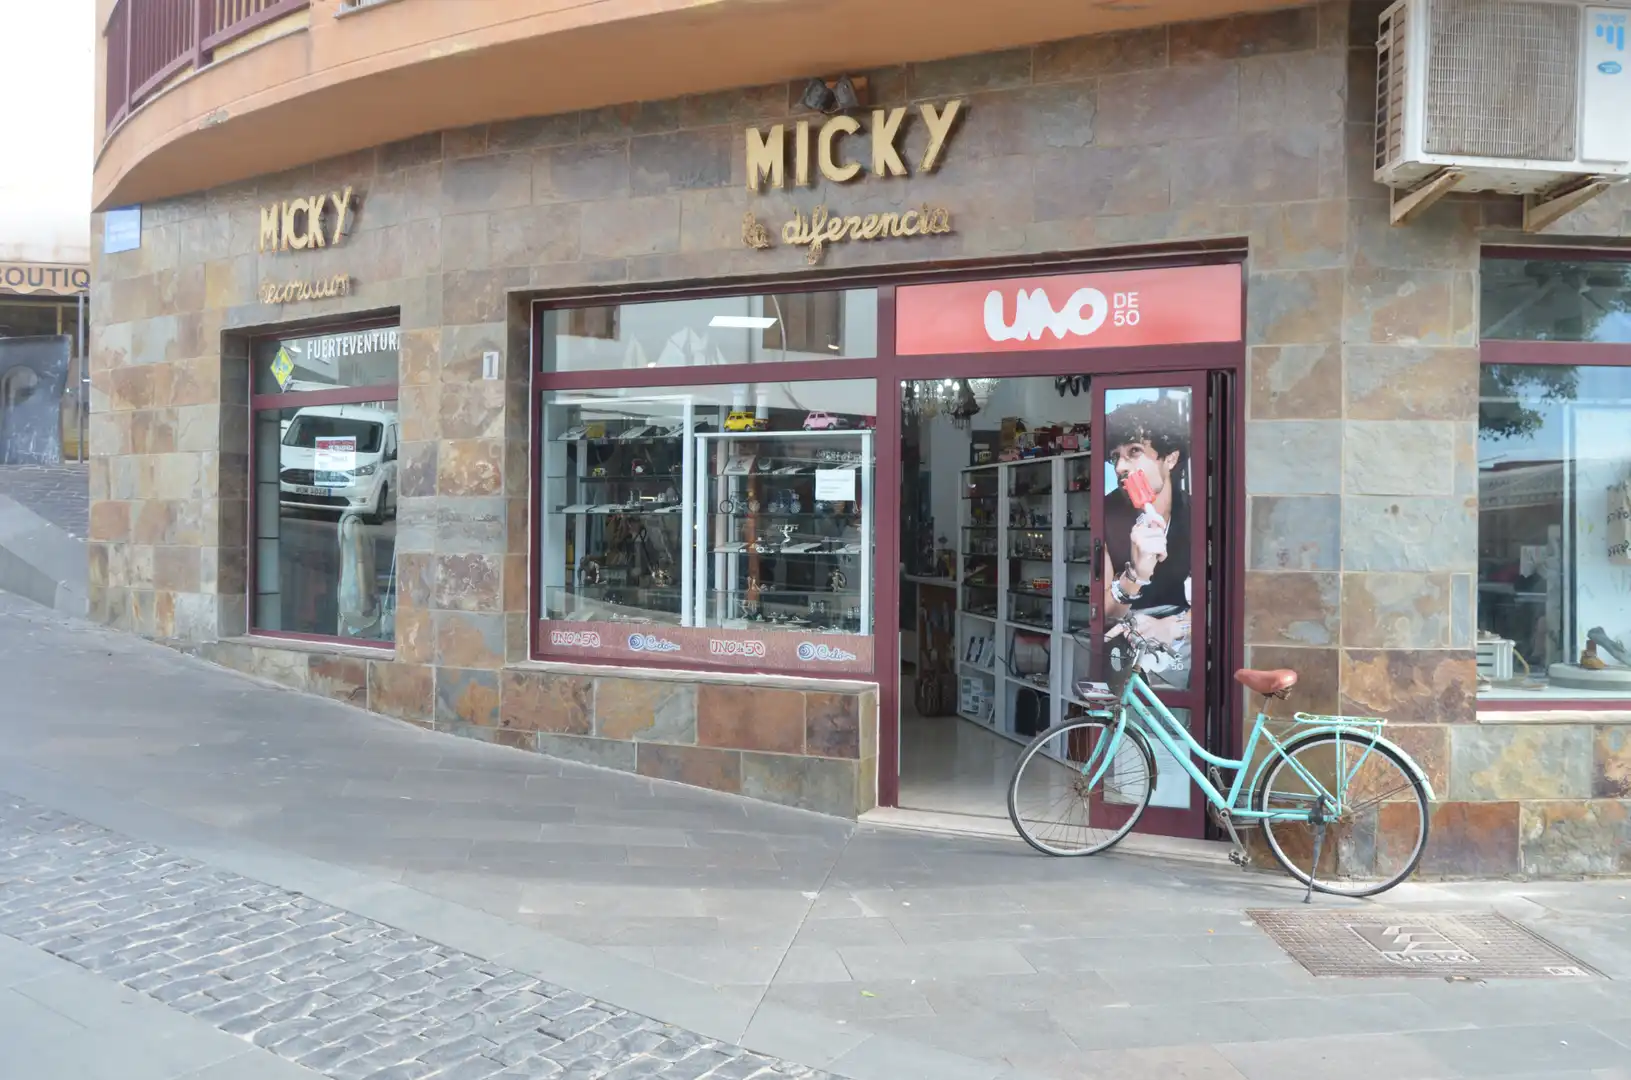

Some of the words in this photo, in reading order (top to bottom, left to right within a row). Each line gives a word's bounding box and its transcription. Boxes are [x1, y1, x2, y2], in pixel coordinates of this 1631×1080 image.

[745, 100, 961, 192] MICKY
[260, 186, 352, 252] MICKY
[782, 203, 950, 264] diferencia
[0, 267, 90, 288] OUTIQ
[1113, 292, 1139, 309] DE
[984, 287, 1108, 341] UNO
[1113, 310, 1140, 326] 50
[307, 331, 399, 359] FUERTEVENTUR
[485, 355, 495, 378] 1
[552, 631, 574, 645] UNO
[582, 632, 600, 648] 50
[711, 640, 735, 653] UNO
[745, 641, 765, 656] 50
